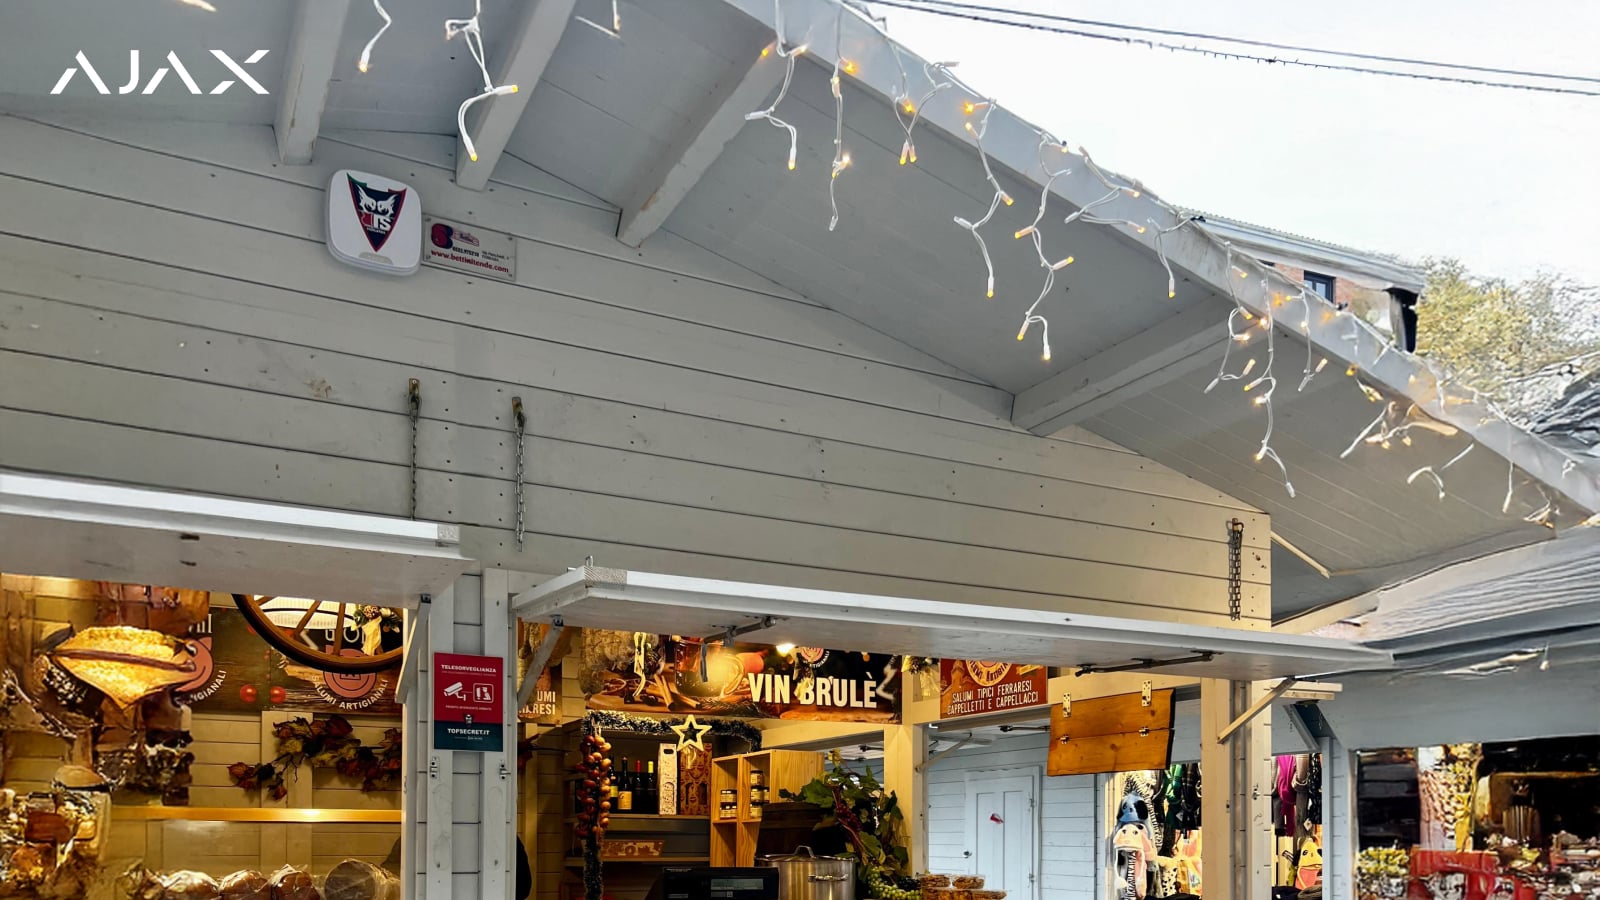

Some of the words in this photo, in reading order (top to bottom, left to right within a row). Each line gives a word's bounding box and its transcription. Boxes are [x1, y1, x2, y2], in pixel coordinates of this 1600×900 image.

[441, 664, 497, 673] TELESORVEGLIANZA
[312, 674, 337, 704] SALUMI
[339, 678, 389, 710] ARTIGIANALI
[748, 672, 791, 704] VIN
[952, 690, 974, 703] SALUMI
[977, 686, 994, 699] TIPICI
[997, 680, 1032, 696] FERRARESI
[947, 699, 985, 715] CAPPELLETTI
[987, 698, 993, 709] E
[996, 691, 1039, 708] CAPPELLACCI
[447, 728, 490, 736] TOPSECRET.IT
